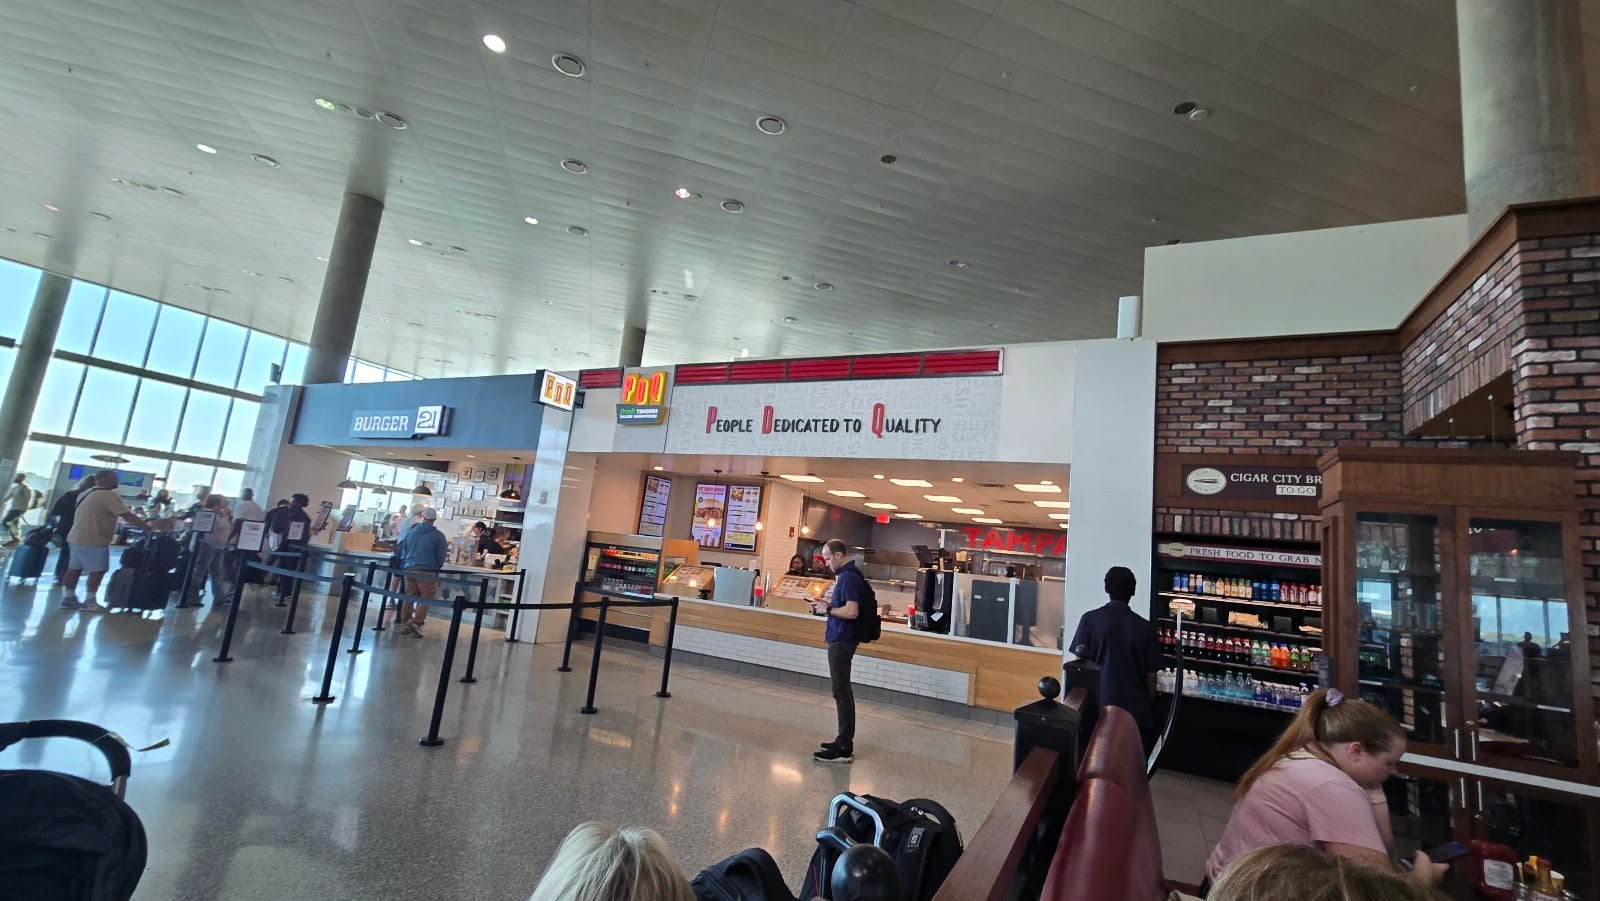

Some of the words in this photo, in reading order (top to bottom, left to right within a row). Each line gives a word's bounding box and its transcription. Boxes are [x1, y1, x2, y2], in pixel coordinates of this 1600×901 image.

[544, 375, 573, 405] PDQ
[622, 371, 667, 406] PDQ
[353, 415, 409, 432] BURGER
[417, 410, 438, 429] 21
[705, 406, 754, 434] PEOPLE
[761, 405, 840, 435] DEDICATED
[843, 418, 862, 433] TO
[872, 402, 942, 439] QUALITY
[1230, 473, 1269, 483] CIGAR
[1272, 474, 1302, 484] CITY
[1278, 486, 1295, 495] TO
[1297, 486, 1315, 495] GO
[1190, 547, 1220, 557] FRESH
[1226, 549, 1255, 560] FOOD
[1259, 552, 1274, 561] TO
[1279, 554, 1310, 564] GRAB
